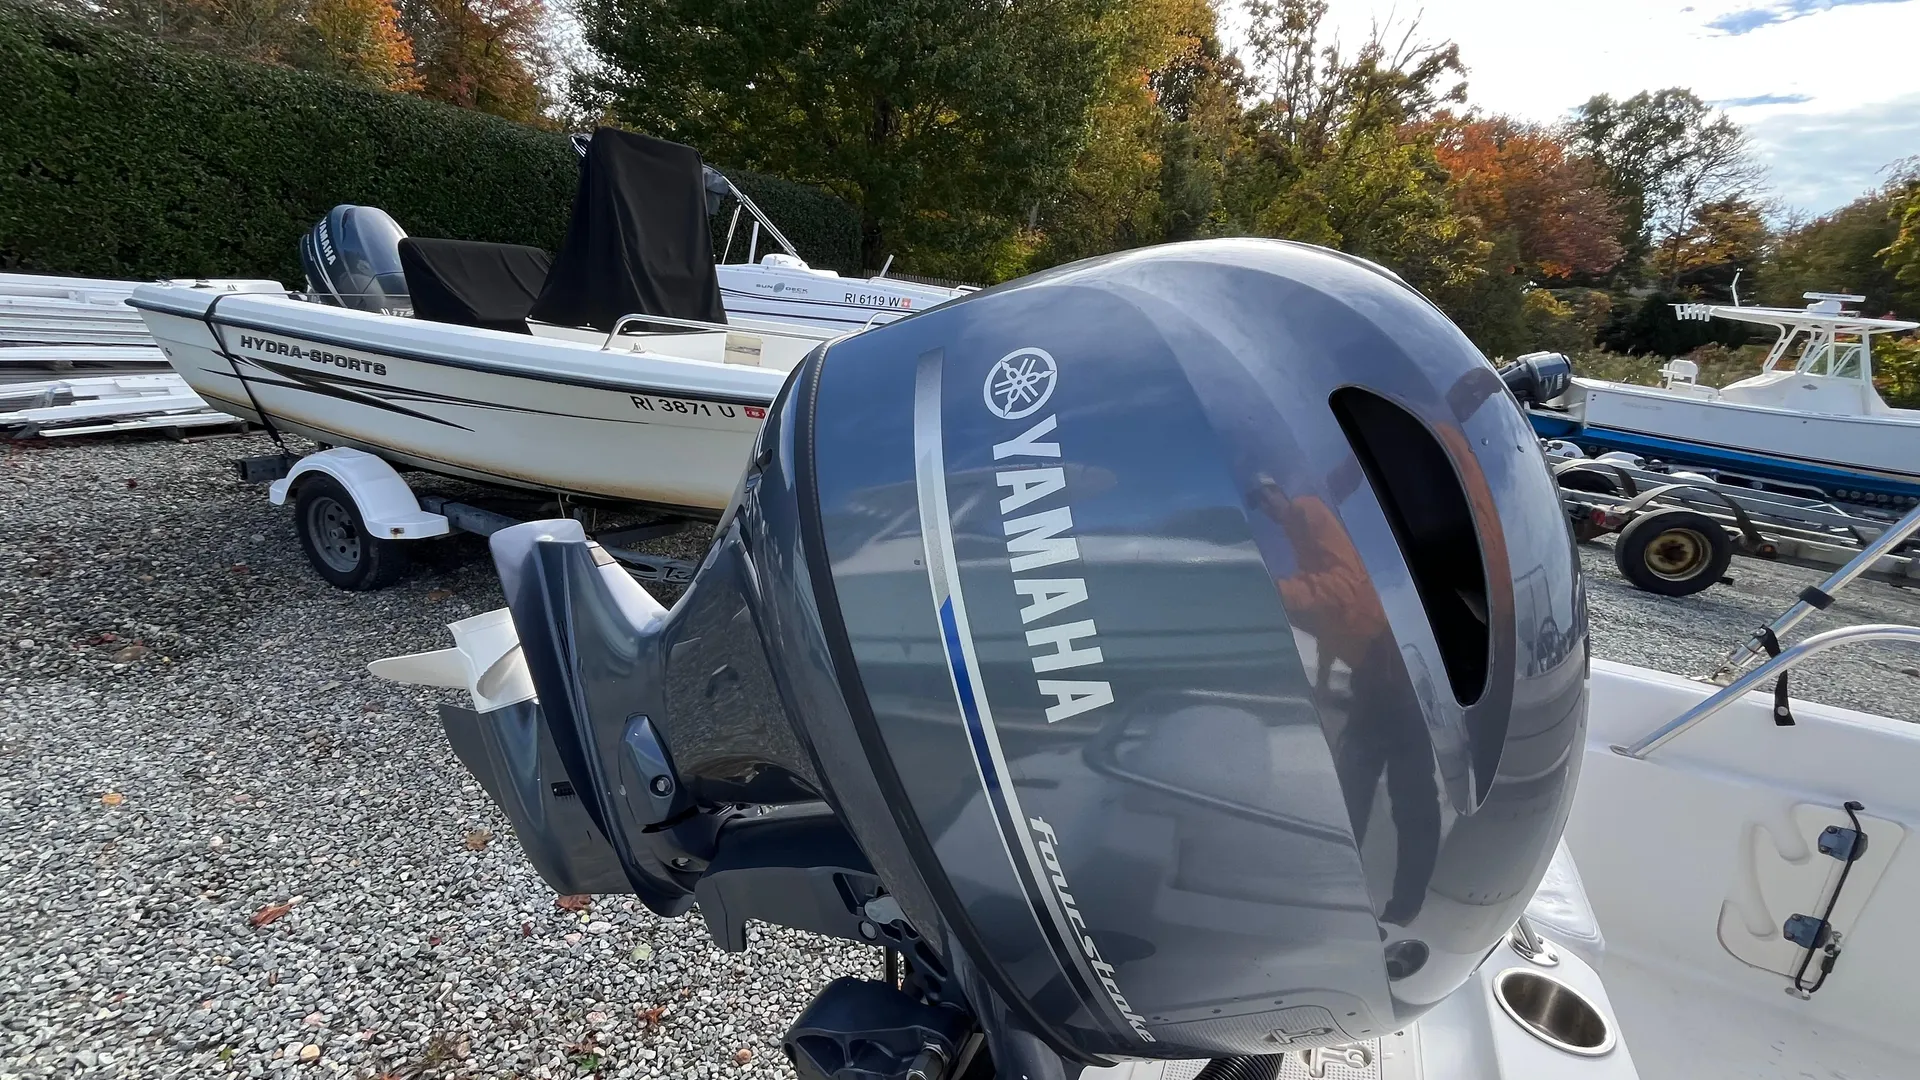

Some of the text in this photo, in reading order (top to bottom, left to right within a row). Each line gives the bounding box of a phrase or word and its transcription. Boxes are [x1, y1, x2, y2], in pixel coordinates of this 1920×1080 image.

[319, 216, 337, 266] YAMAHA
[844, 293, 900, 307] RI 6119 W
[240, 335, 387, 376] HYDRA-SPORTS
[630, 395, 655, 411] RI
[658, 399, 711, 417] 3871
[718, 405, 736, 418] U
[992, 413, 1115, 724] YAMAHA
